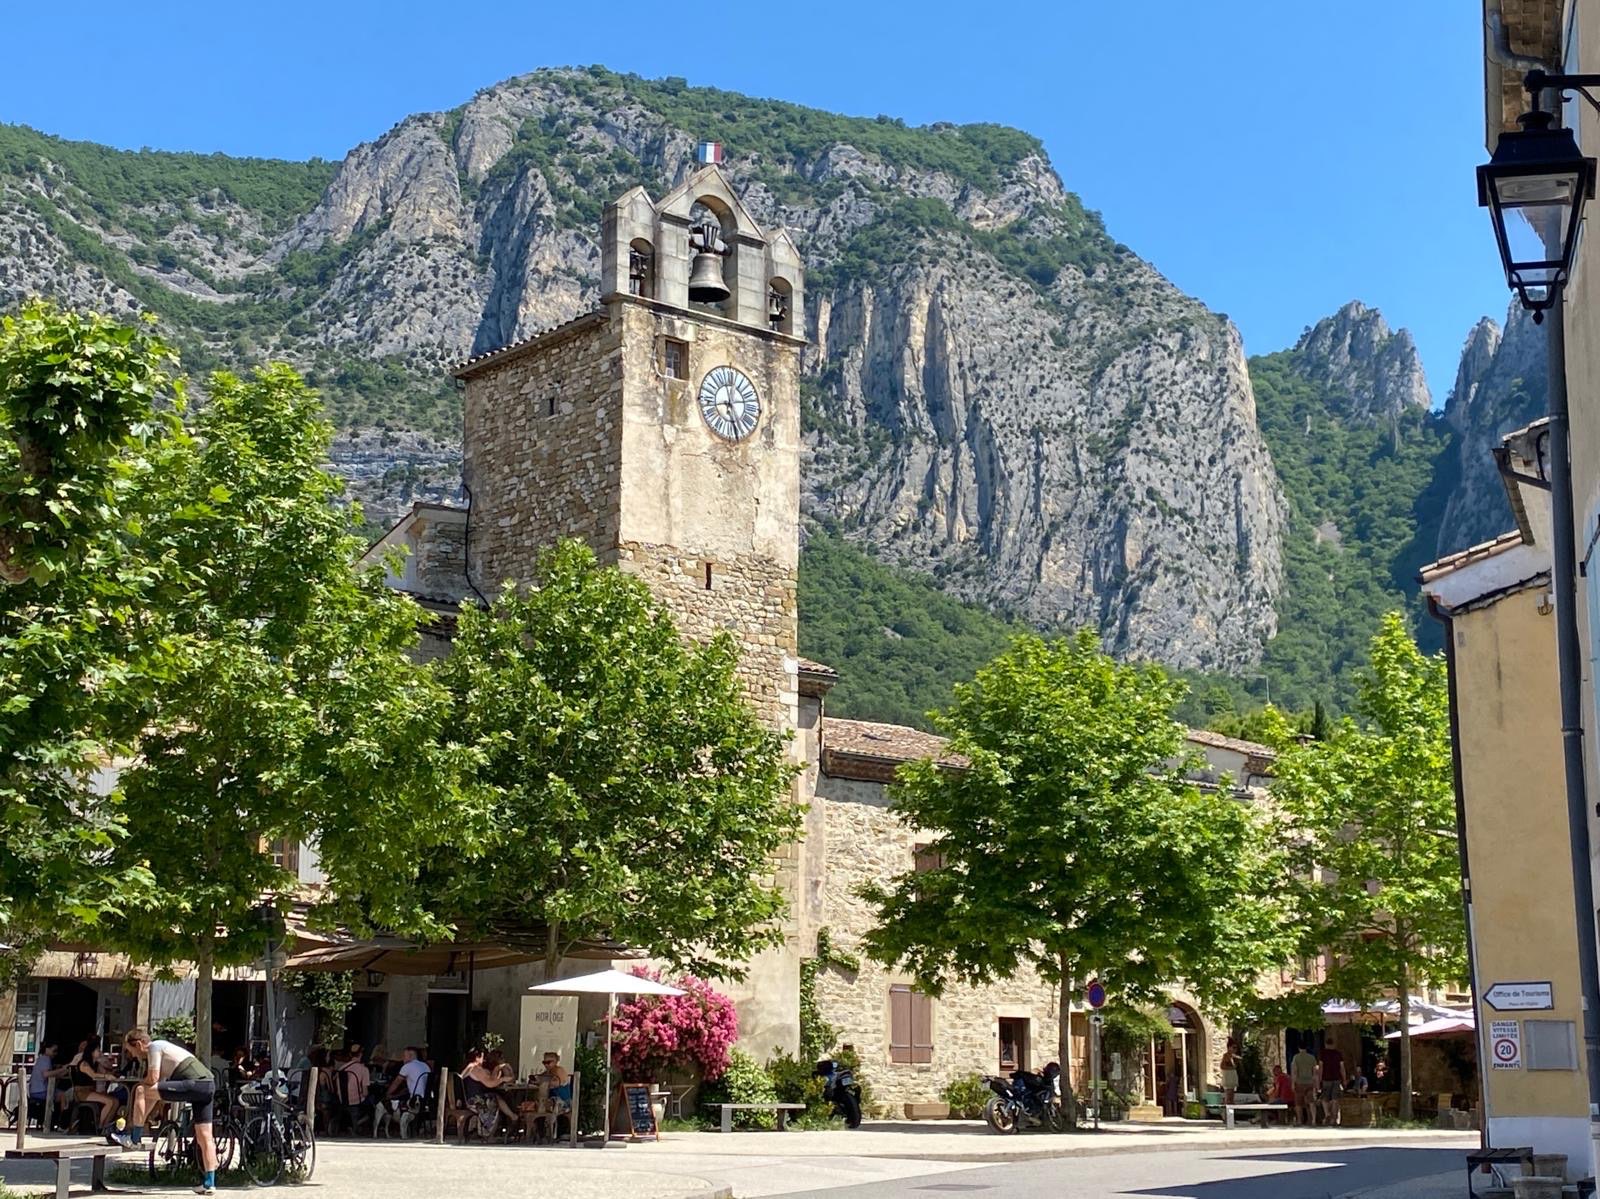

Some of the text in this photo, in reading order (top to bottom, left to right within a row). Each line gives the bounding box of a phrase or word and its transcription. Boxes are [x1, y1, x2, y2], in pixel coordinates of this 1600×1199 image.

[1493, 990, 1511, 998] Office
[1521, 989, 1550, 998] Tourisme
[1500, 1045, 1512, 1055] 20
